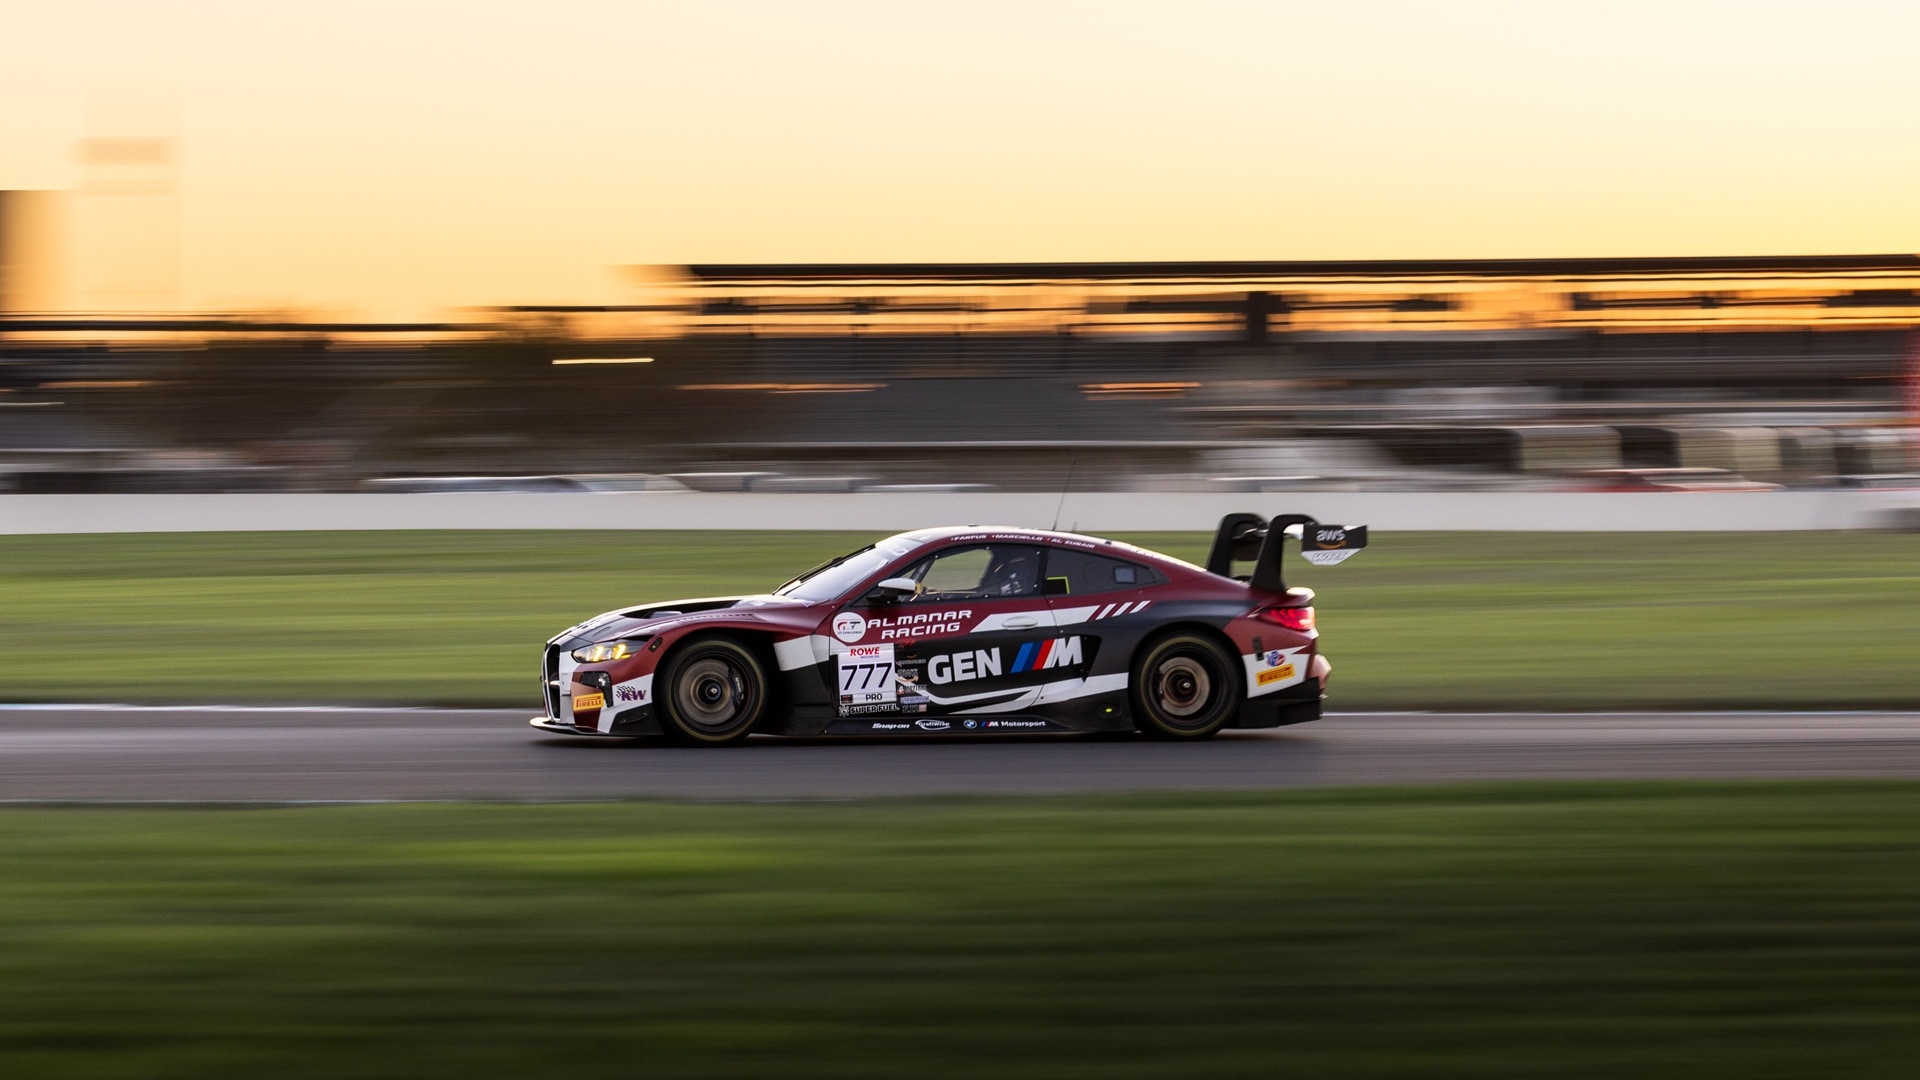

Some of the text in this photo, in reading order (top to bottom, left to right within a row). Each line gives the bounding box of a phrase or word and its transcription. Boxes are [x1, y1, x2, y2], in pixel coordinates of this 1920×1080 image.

[1316, 529, 1346, 542] aws
[867, 609, 972, 629] ALMANAR
[881, 621, 961, 640] RACING
[850, 646, 880, 657] ROWE
[927, 646, 1002, 685] GEN
[841, 662, 892, 691] 777
[575, 695, 603, 708] PIRELLI
[620, 689, 647, 701] KW
[865, 693, 882, 702] PRO
